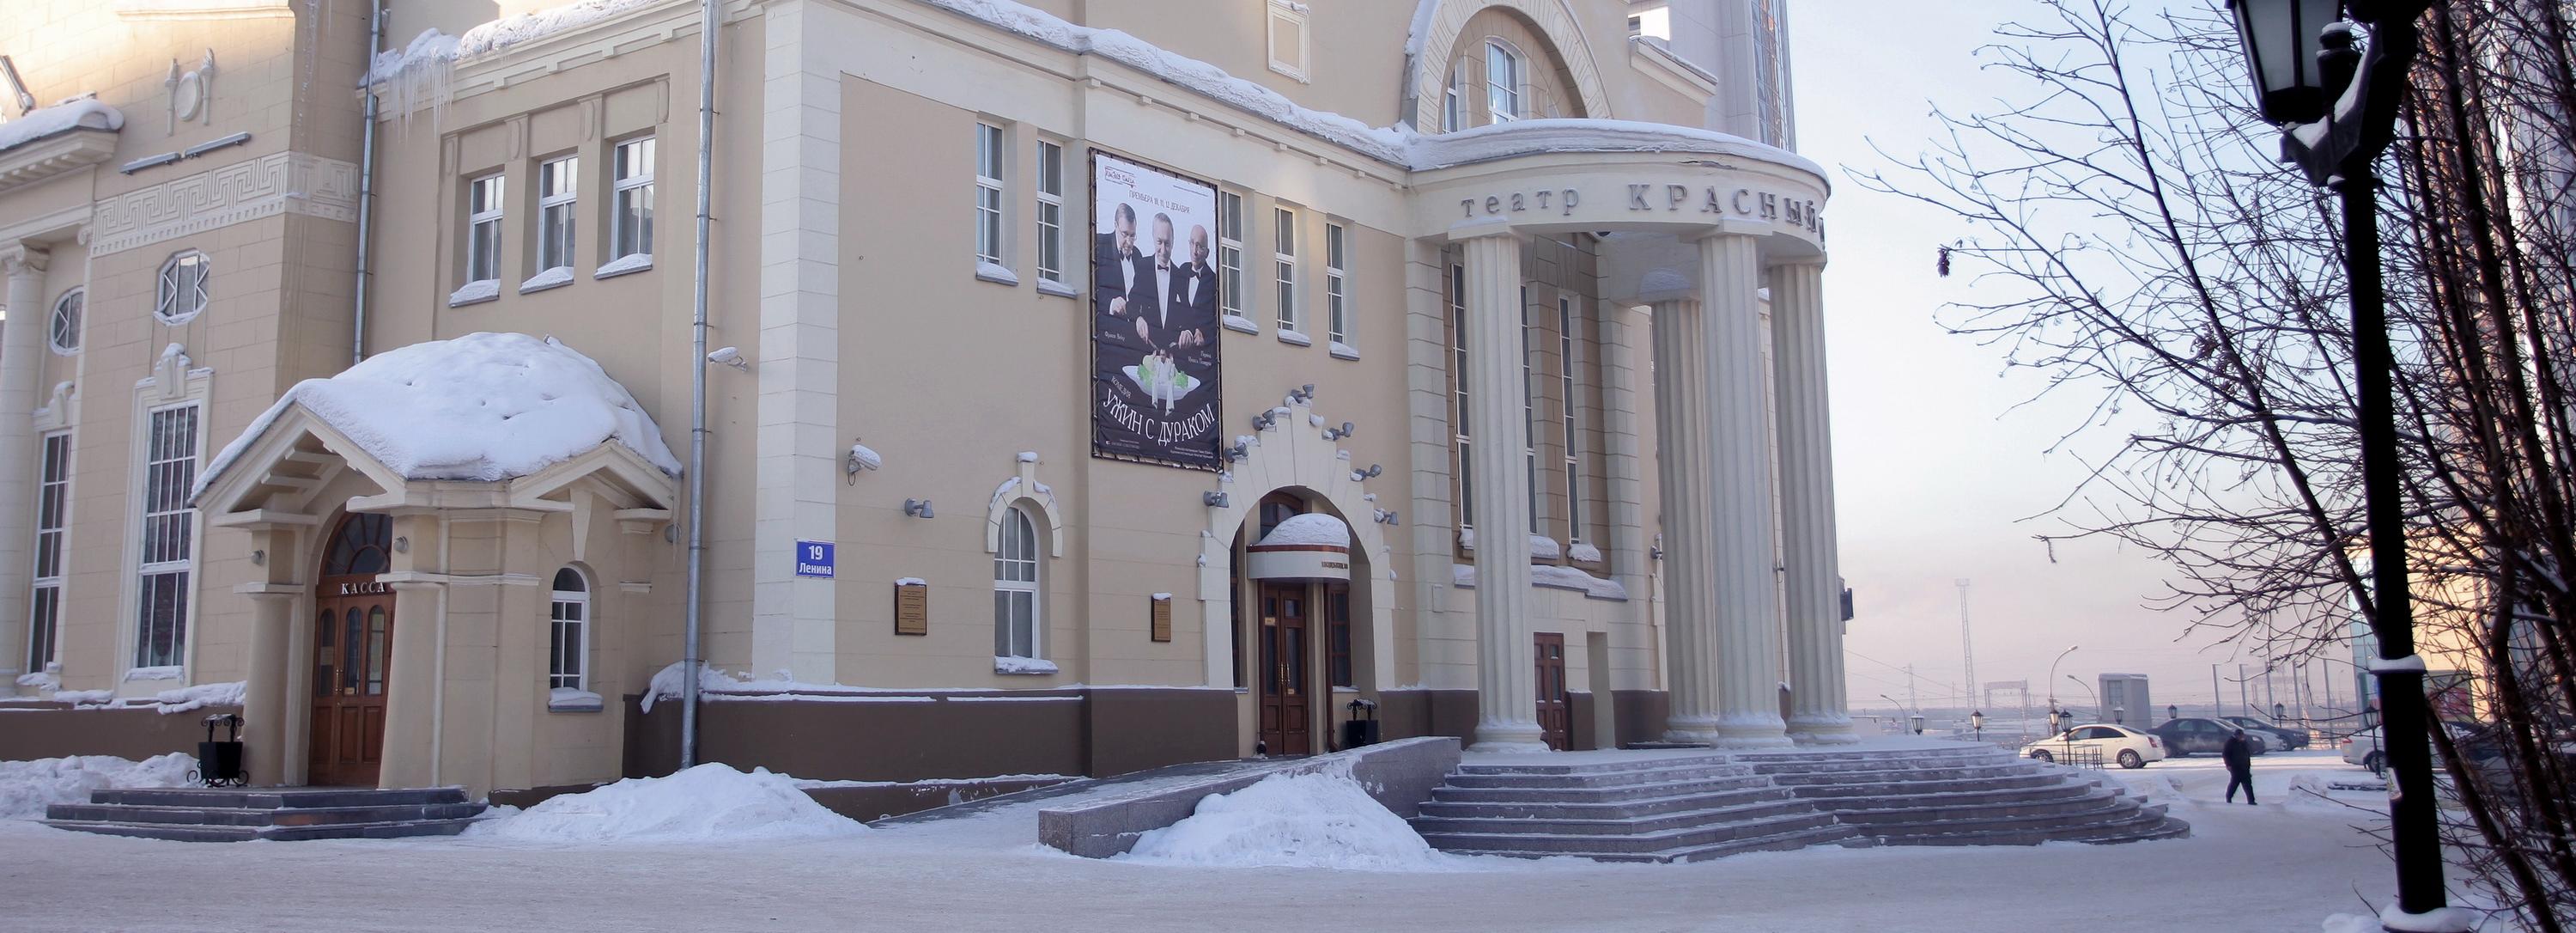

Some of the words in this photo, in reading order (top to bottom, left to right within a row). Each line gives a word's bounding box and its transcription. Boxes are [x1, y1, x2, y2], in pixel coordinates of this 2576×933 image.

[1129, 190, 1154, 204] ПРЕМЬЕРА
[1170, 202, 1190, 214] ДЕКАБРЯ
[1461, 187, 1579, 216] театр
[1627, 183, 1818, 234] КРАСНЫЙ
[1111, 375, 1132, 399] КОМЕДИЯ
[1103, 388, 1143, 435] УЖИН
[1145, 418, 1155, 440] С
[1157, 403, 1215, 447] ДУРАКОМ
[808, 545, 823, 560] 19
[799, 562, 832, 575] Ленина
[341, 582, 386, 595] КАССА
